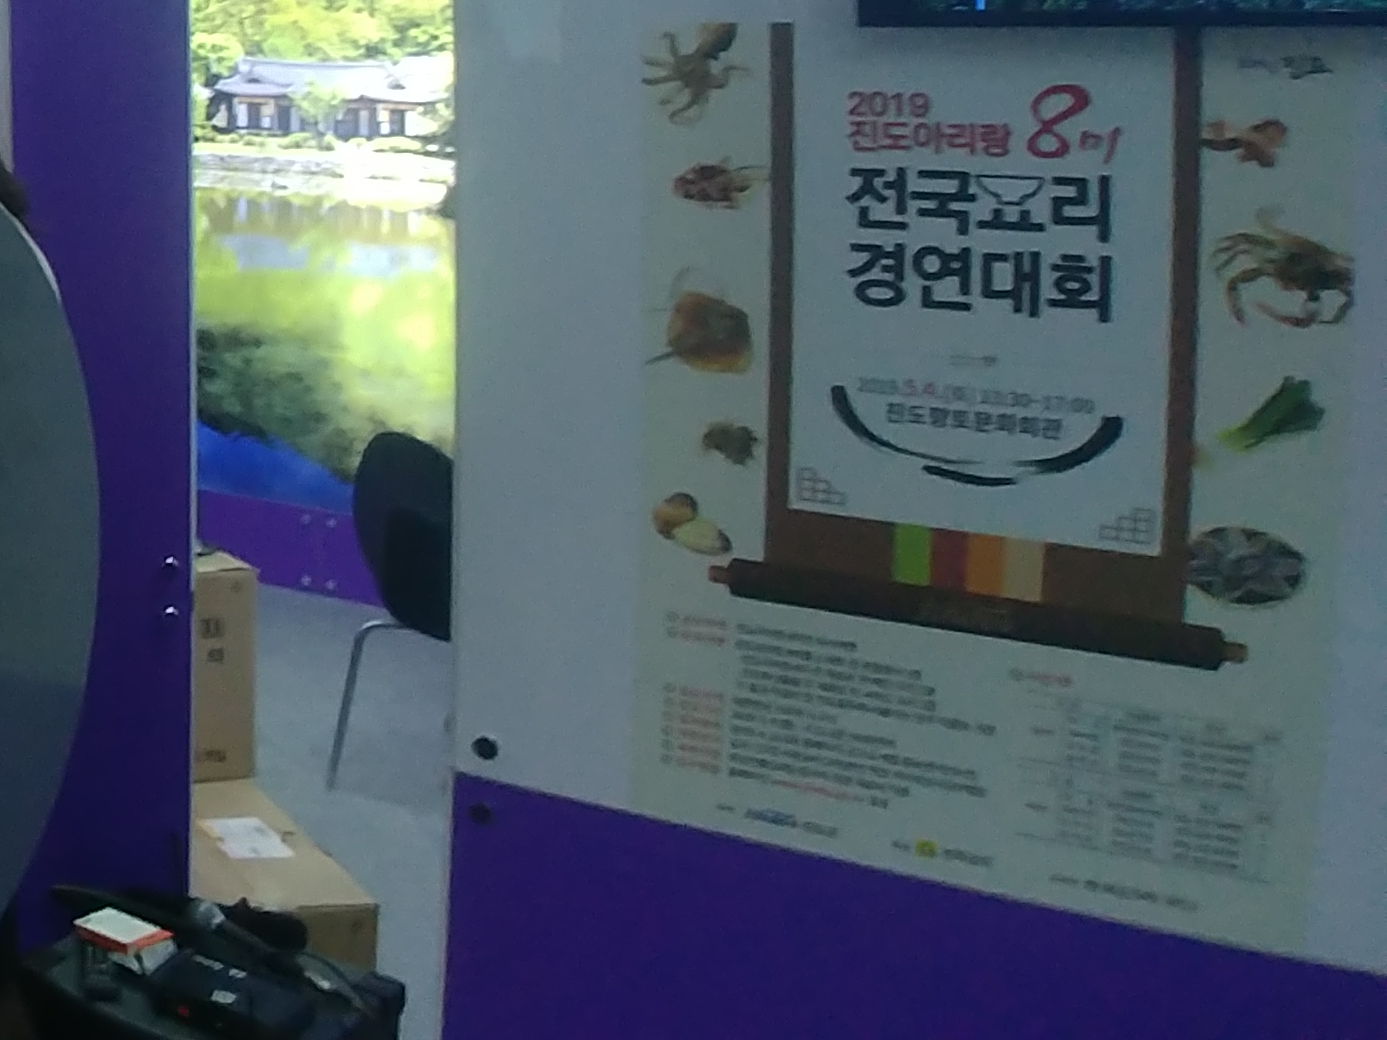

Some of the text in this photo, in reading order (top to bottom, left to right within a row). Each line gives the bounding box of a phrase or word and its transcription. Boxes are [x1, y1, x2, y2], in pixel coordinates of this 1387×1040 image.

[847, 90, 931, 118] 2019
[846, 119, 1013, 158] 진도아리랑
[844, 166, 1112, 244] 전국요리
[845, 242, 1113, 324] 경연대회
